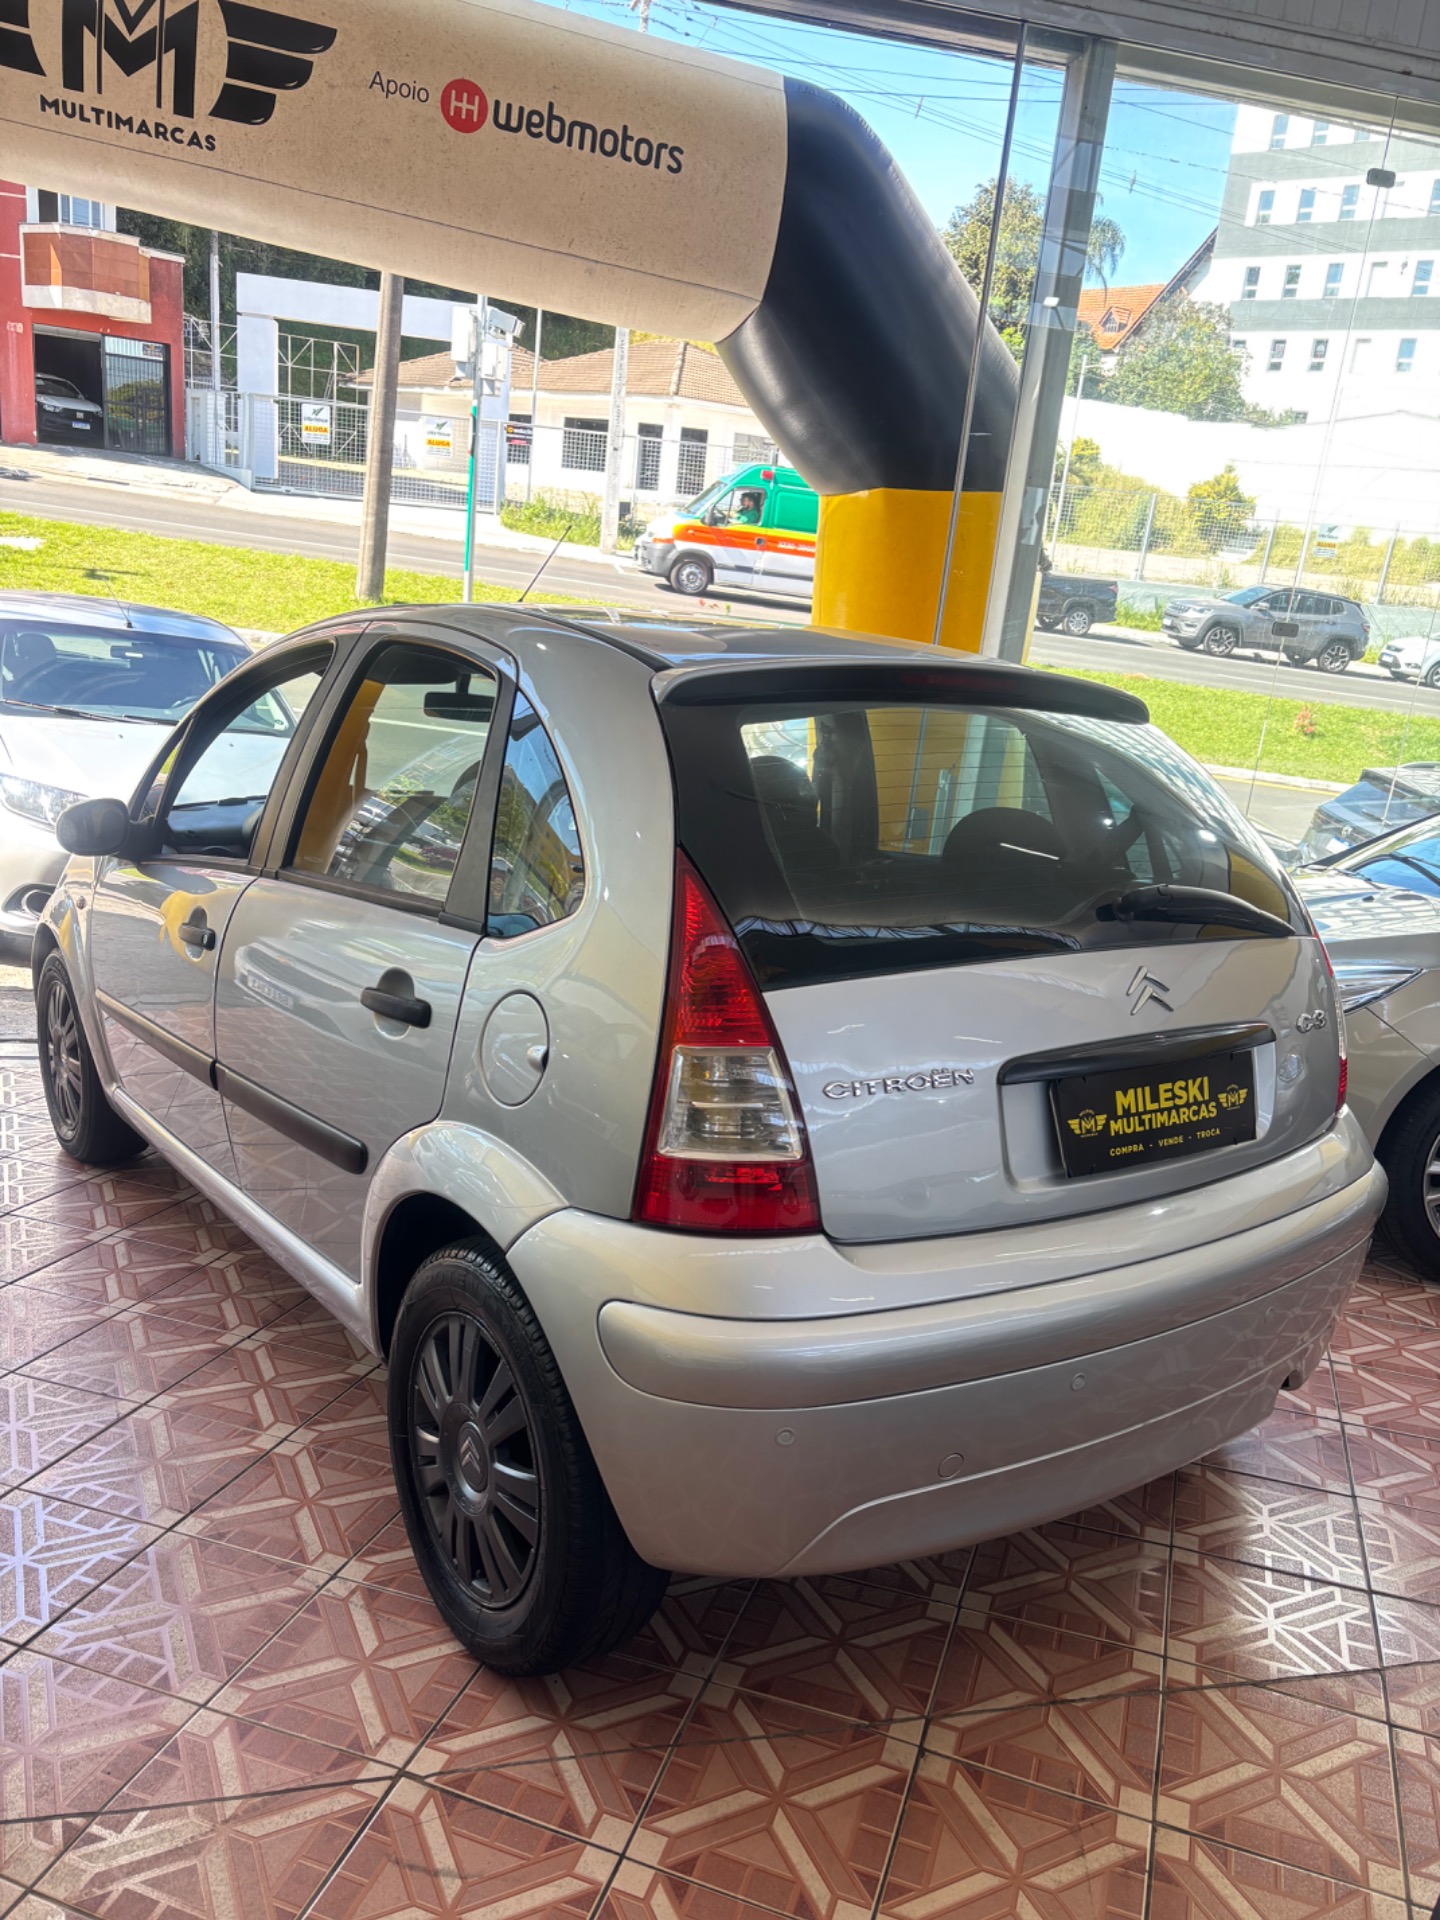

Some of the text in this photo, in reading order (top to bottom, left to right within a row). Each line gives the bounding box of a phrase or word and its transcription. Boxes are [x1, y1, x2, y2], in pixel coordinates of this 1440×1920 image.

[39, 93, 217, 152] MULTIMARCAS
[368, 70, 685, 174] Apoio webmotors
[303, 425, 328, 434] ALUGA
[1296, 1009, 1327, 1034] C3
[822, 1067, 975, 1100] CITROËN
[1115, 1076, 1210, 1116] MILESKI
[1109, 1101, 1218, 1137] MULTIMARCAS
[1109, 1143, 1145, 1157] COMPRA
[1158, 1135, 1184, 1147] VENDE
[1196, 1127, 1221, 1140] TROCA
